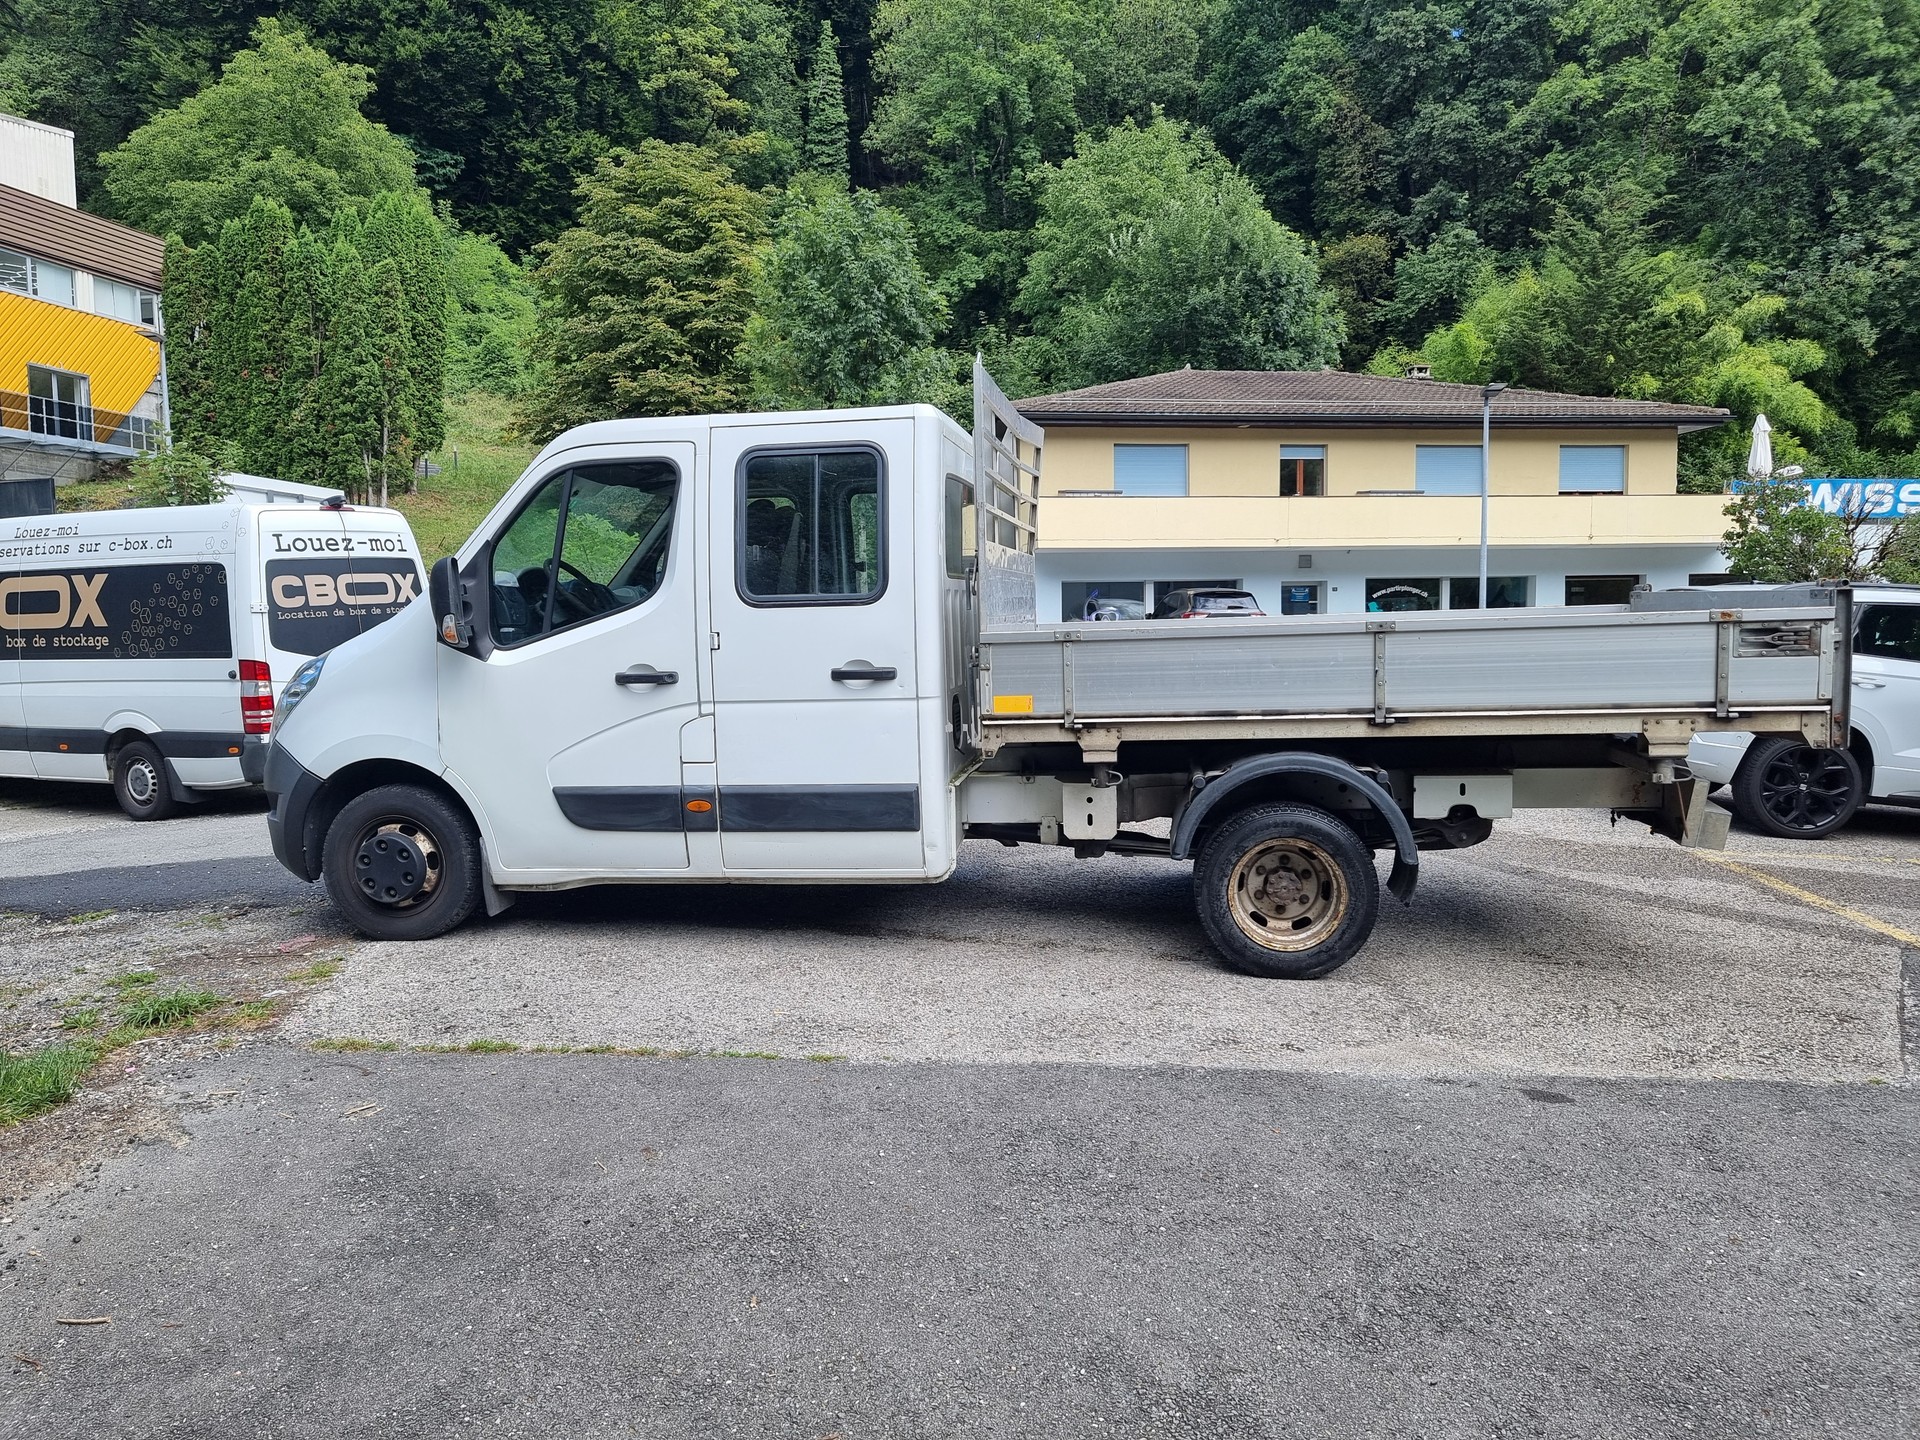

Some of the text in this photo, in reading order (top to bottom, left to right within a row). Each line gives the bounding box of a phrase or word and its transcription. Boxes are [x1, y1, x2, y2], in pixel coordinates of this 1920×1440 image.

[14, 523, 79, 539] Louez-moi
[78, 542, 101, 553] sur
[108, 536, 173, 552] c-box.ch
[272, 533, 407, 552] Louez-moi
[271, 573, 417, 608] CBOX
[277, 609, 329, 620] Location
[333, 608, 345, 617] de
[349, 607, 367, 616] box
[371, 606, 382, 615] de
[5, 633, 110, 650] box de stockage
